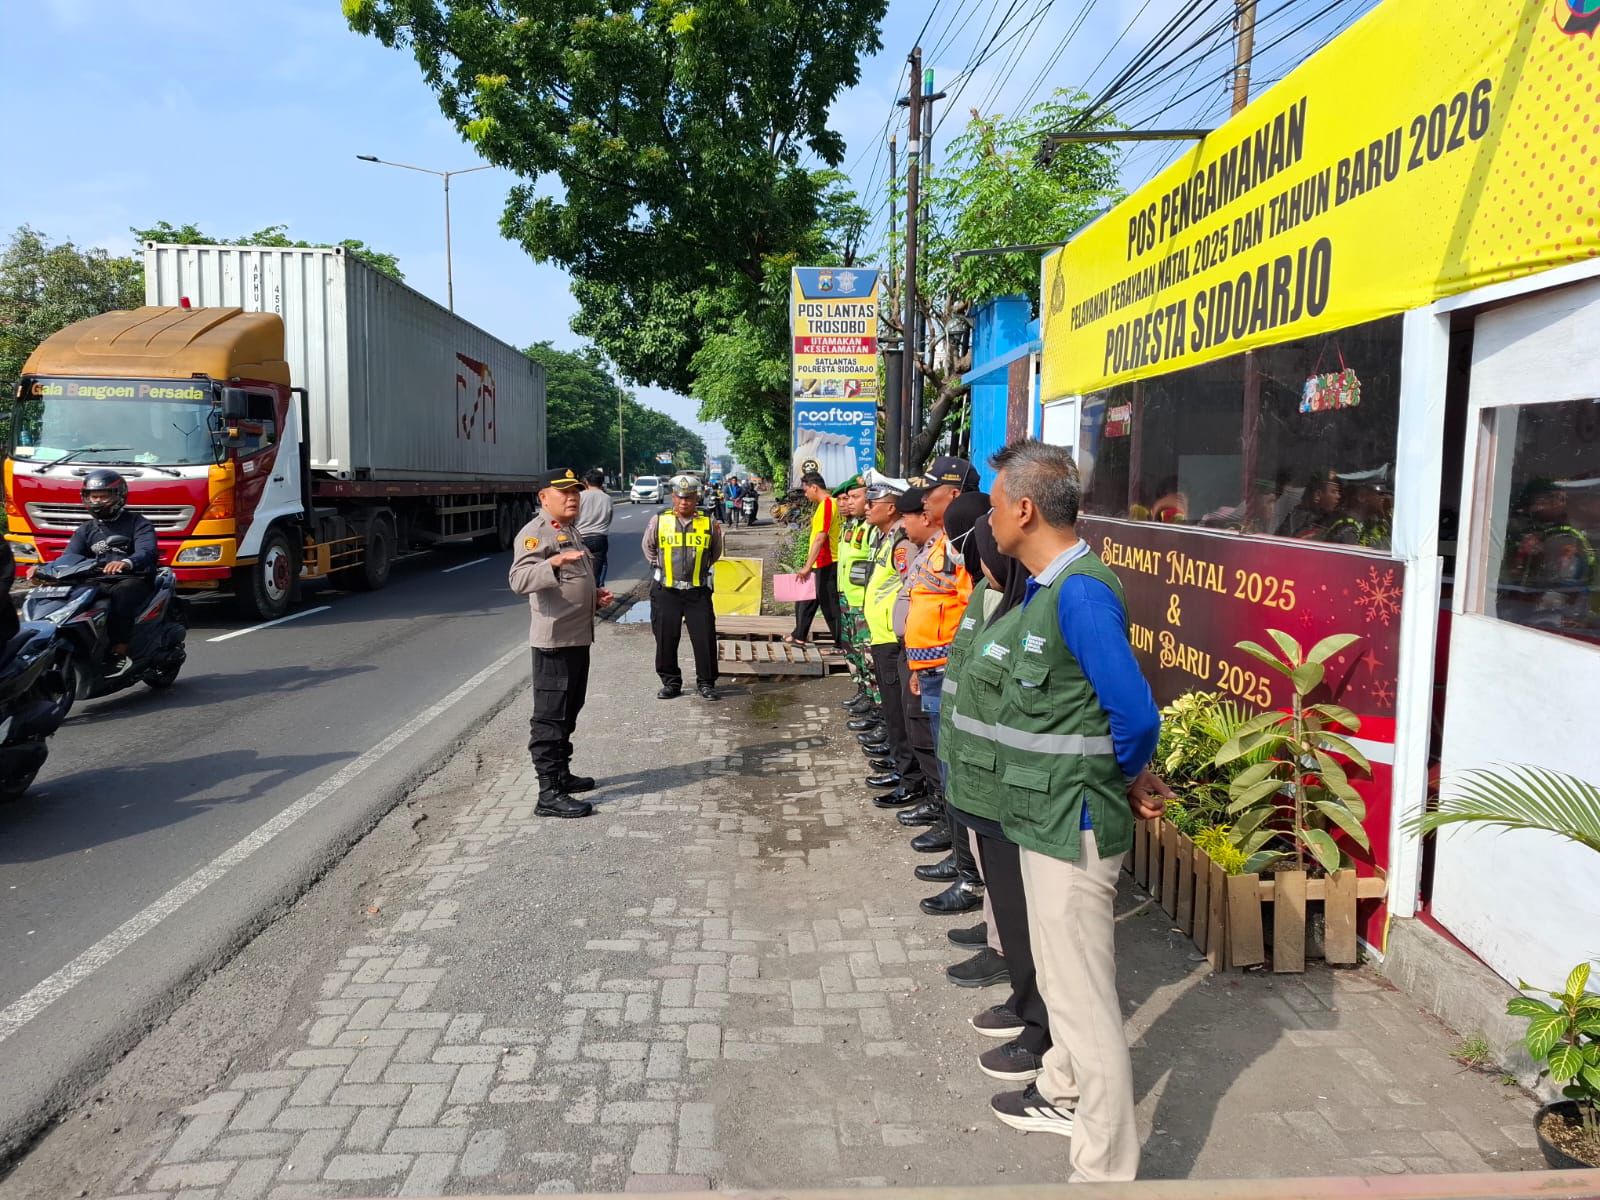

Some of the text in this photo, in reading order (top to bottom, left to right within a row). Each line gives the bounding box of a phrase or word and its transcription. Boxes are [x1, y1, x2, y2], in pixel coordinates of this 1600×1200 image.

[1127, 96, 1308, 261] POS PENGAMANAN
[1070, 78, 1492, 332] PELAYANAN PERAYAAN NATAL 2025 DAN TAHUN BARU 2026
[798, 304, 874, 318] POS LANTAS
[1103, 236, 1332, 377] POLRESTA SIDOARJO
[807, 320, 866, 334] TROSOBO
[803, 345, 869, 353] KESELAMATAN
[811, 337, 862, 345] UTAMAKAN
[798, 365, 874, 373] POLRESTA SIDOARJO
[815, 358, 857, 366] SATLANTAS
[31, 383, 204, 401] Gala Bangoen Persada
[798, 408, 864, 425] rooftop
[1233, 569, 1297, 612] 2025
[1166, 593, 1181, 627] &
[1216, 660, 1272, 708] 2025
